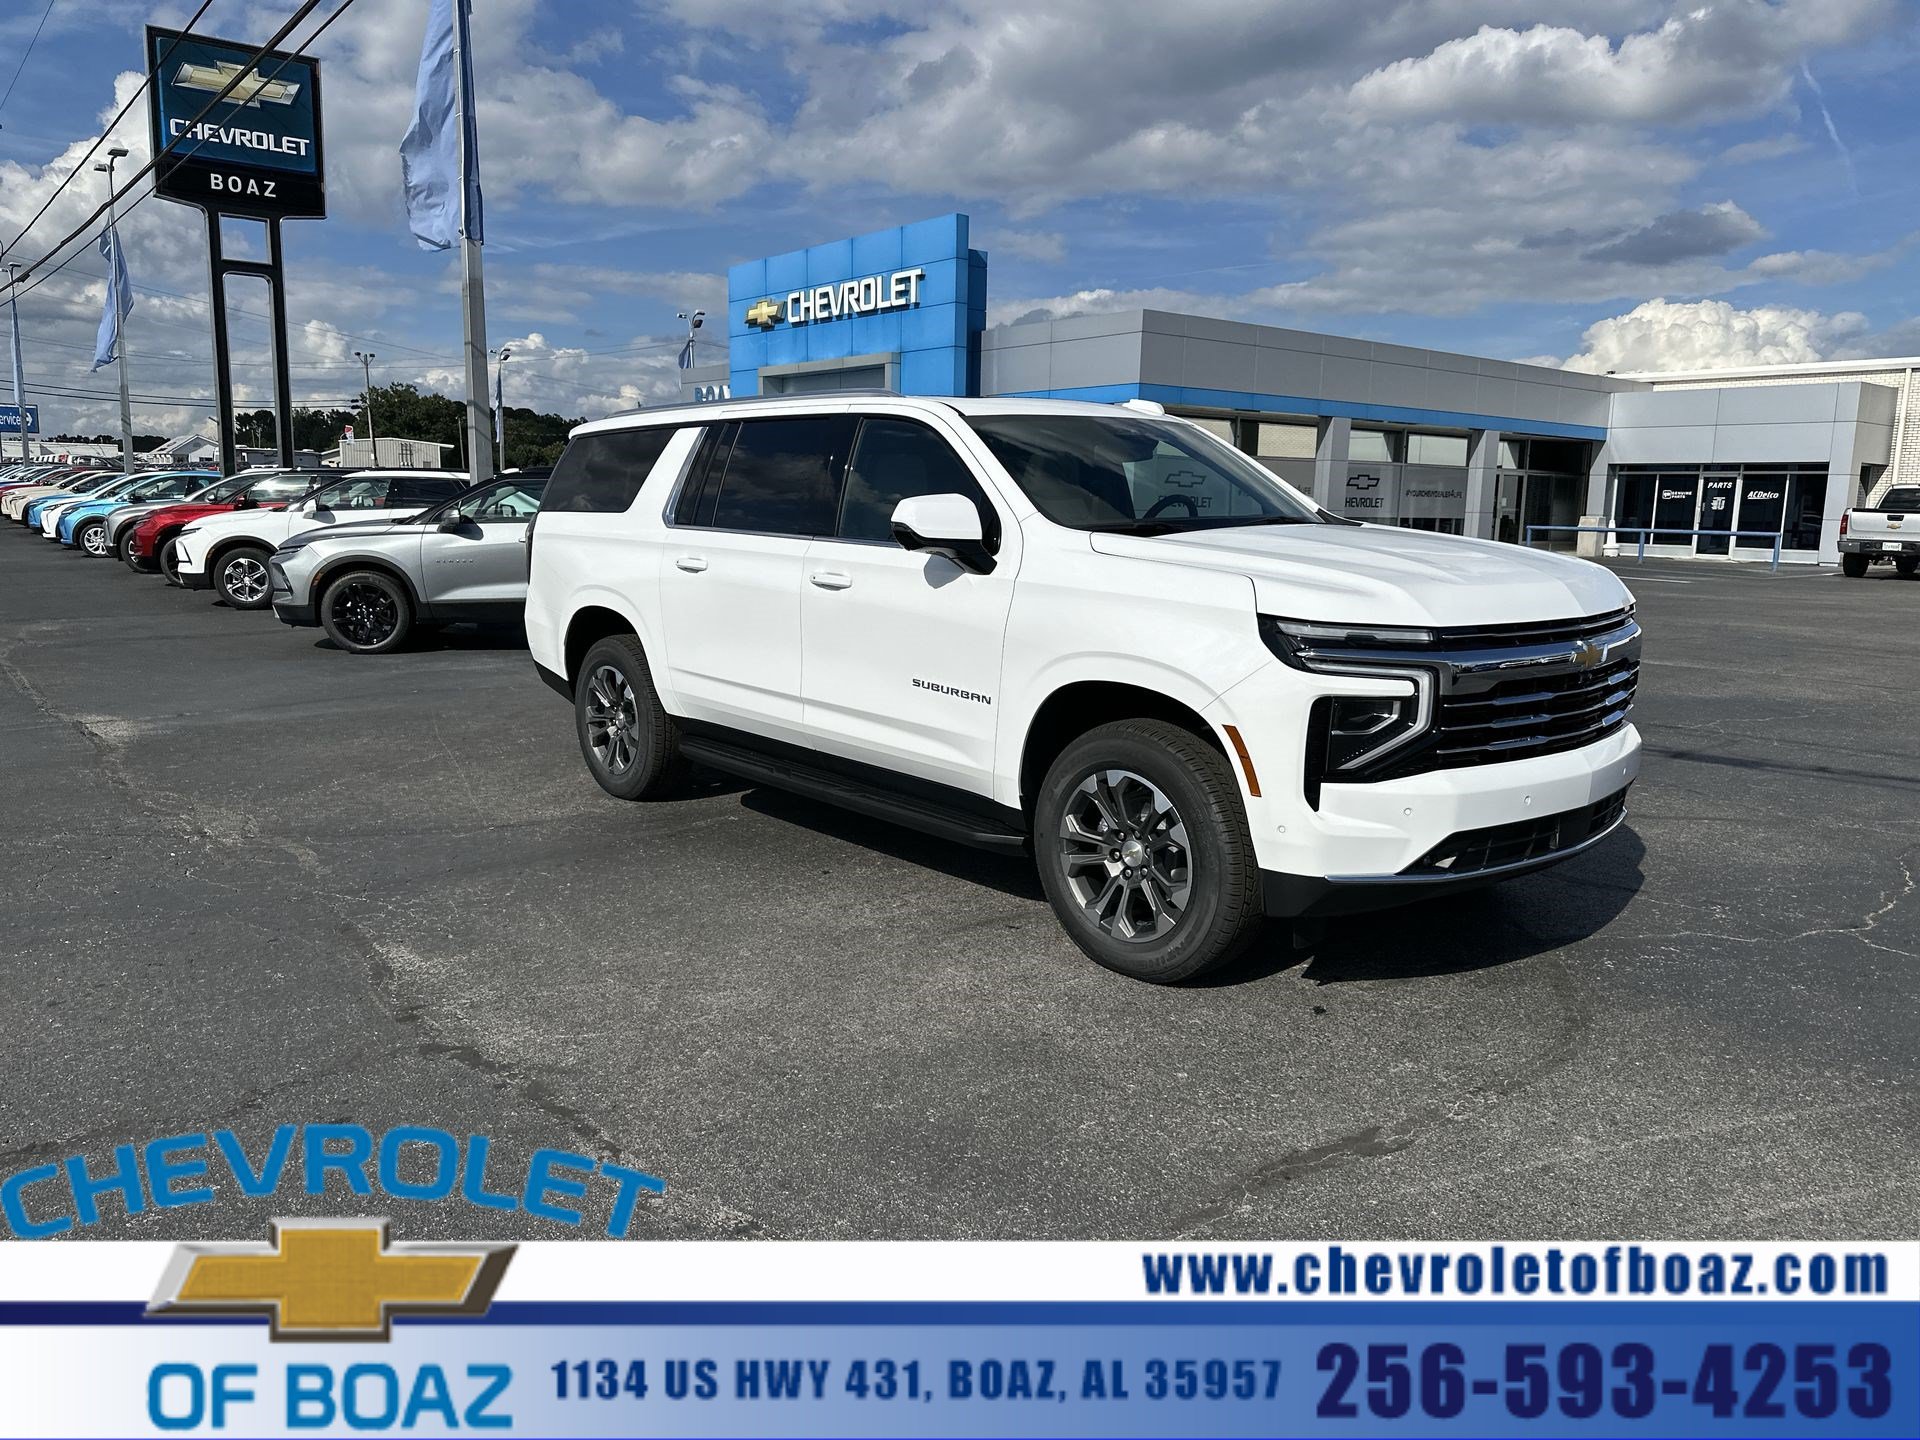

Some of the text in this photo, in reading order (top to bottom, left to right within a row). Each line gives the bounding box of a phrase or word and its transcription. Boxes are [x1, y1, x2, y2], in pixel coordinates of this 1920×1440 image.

[169, 118, 310, 156] CHEVROLET
[210, 173, 277, 198] BOAZ
[787, 268, 922, 323] CHEVROLET
[695, 385, 731, 402] BOA
[0, 412, 21, 425] ervice
[1345, 497, 1384, 508] HEVROLET
[1747, 491, 1779, 499] ACDelco
[912, 678, 992, 705] SUBURBAN
